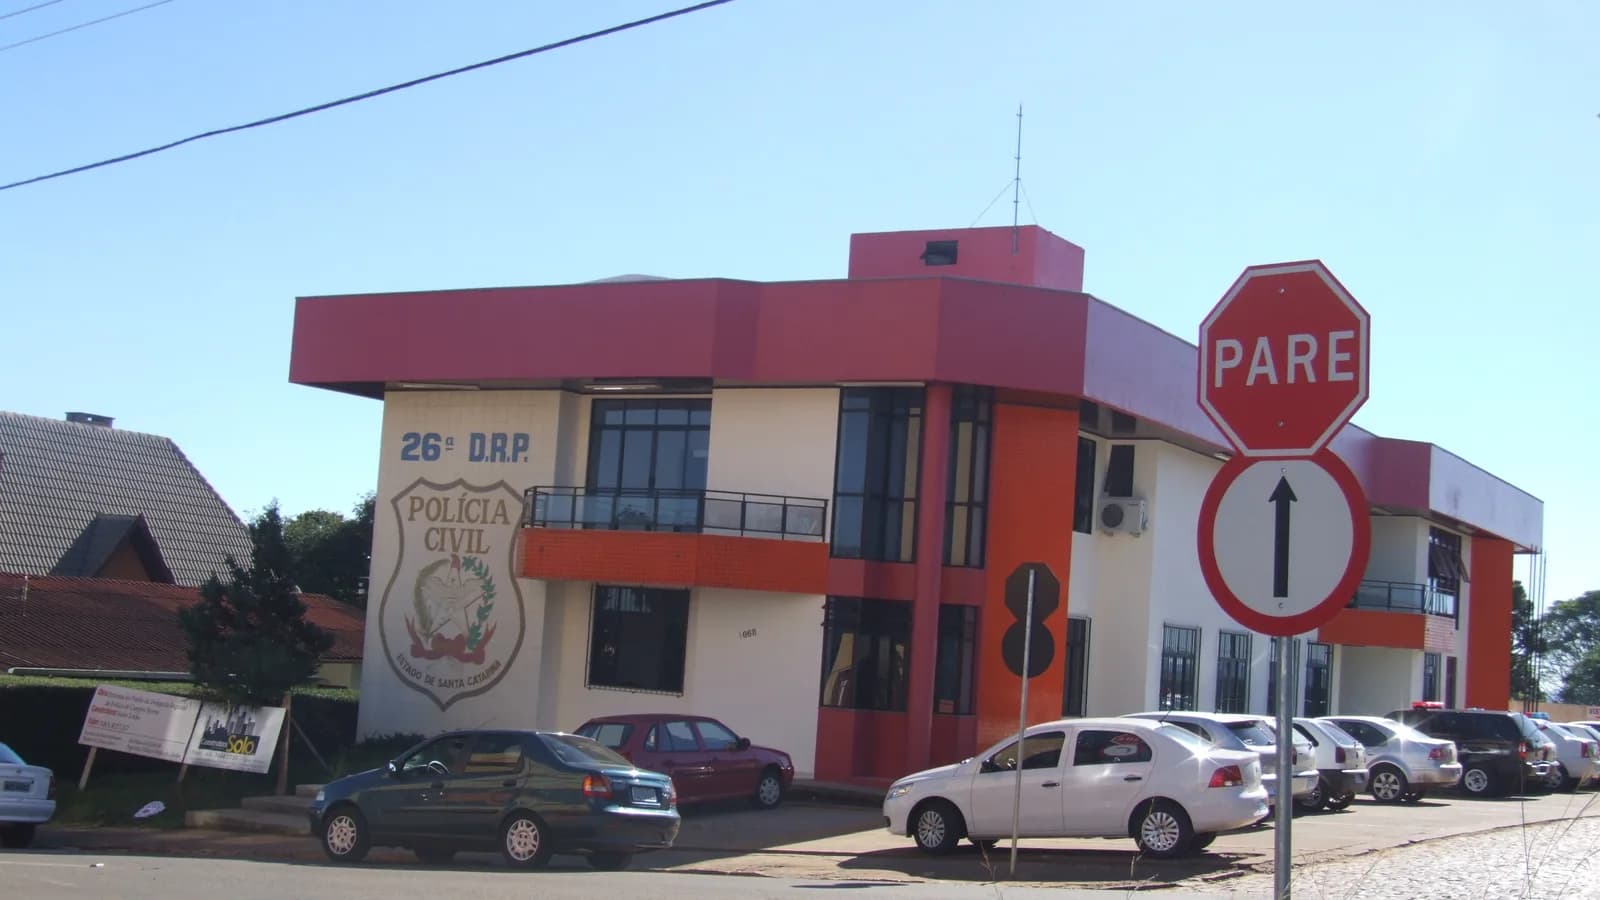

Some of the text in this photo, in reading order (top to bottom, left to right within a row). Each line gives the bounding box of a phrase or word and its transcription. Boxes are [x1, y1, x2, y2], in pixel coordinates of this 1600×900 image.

[1214, 330, 1355, 388] PARE
[468, 432, 530, 463] D.R.P.
[407, 492, 511, 526] POLÍCIA
[424, 527, 490, 555] CIVIL
[396, 653, 422, 680] ESTADO
[424, 674, 435, 687] DE
[437, 679, 466, 689] SANTA
[226, 734, 255, 754] Solo
